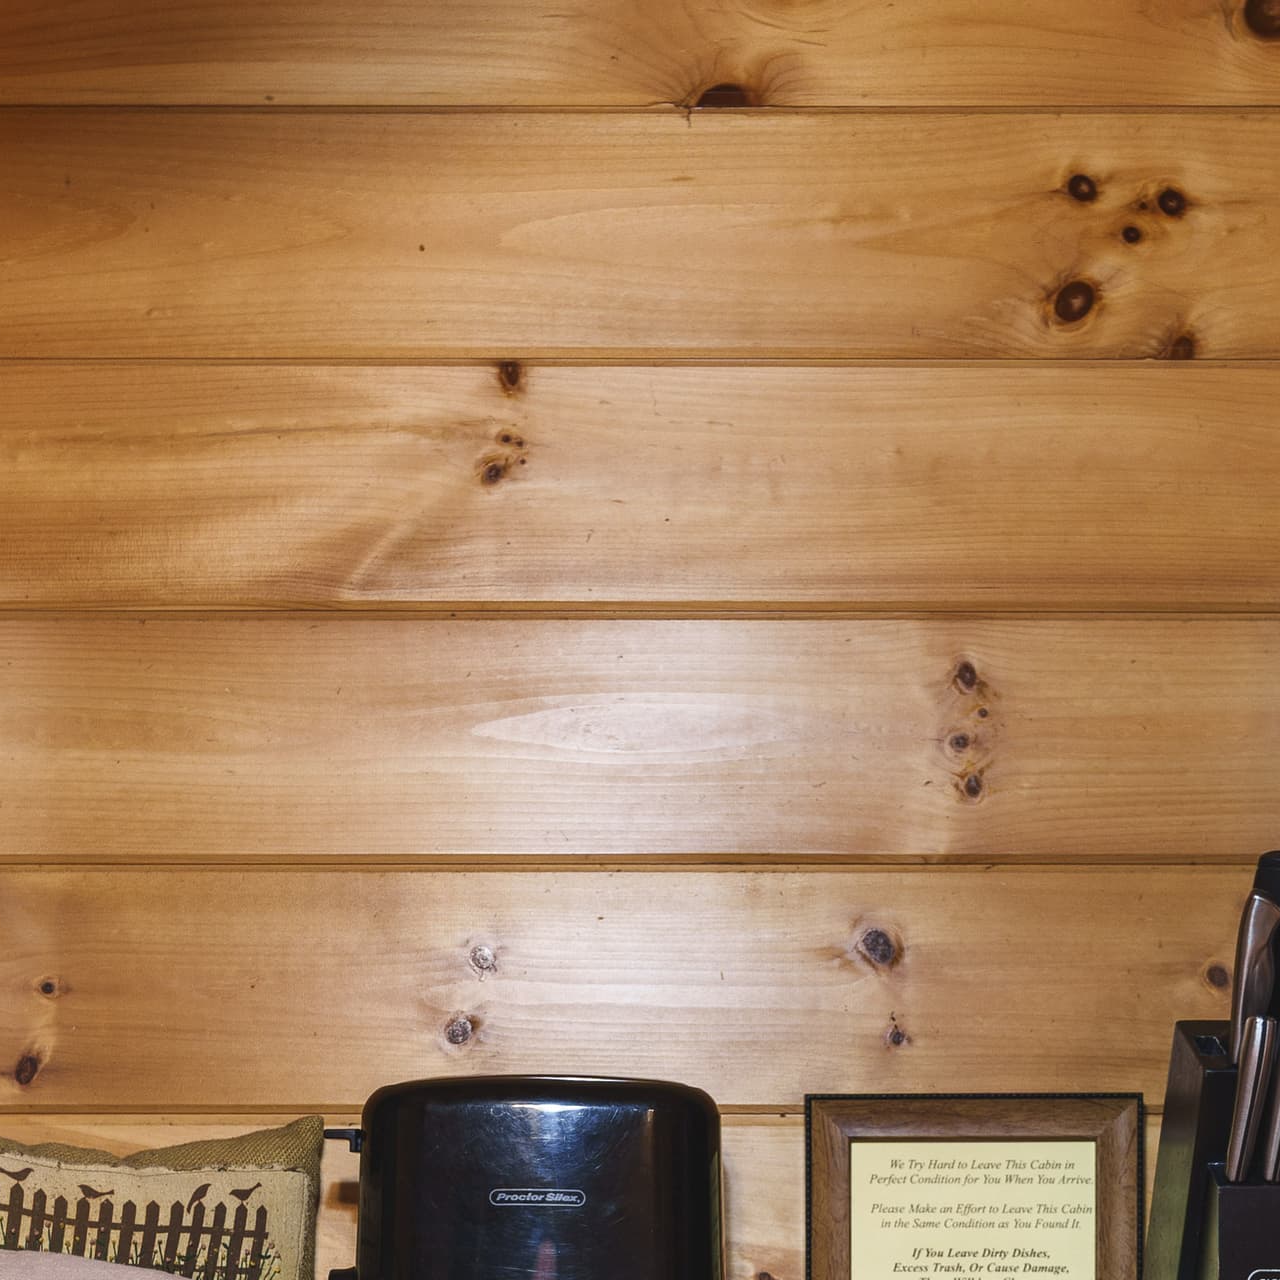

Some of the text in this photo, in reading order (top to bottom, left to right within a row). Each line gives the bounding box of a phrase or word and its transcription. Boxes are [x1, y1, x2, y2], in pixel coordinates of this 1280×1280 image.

[890, 1160, 1075, 1172] We Try Hard to Leave This Cabin in
[870, 1174, 1094, 1187] Perfect Condition for You When You Arrive.
[496, 1192, 544, 1201] Proctor
[870, 1203, 1093, 1216] Please Make an Effort to Leave This Cabin
[880, 1219, 891, 1229] in
[894, 1219, 910, 1229] the
[912, 1219, 941, 1229] Same
[944, 1219, 996, 1229] Condition
[998, 1221, 1009, 1229] as
[1014, 1219, 1032, 1229] You
[1034, 1219, 1070, 1229] Found
[912, 1248, 1051, 1260] If You Leave Dirty Dishes,
[893, 1263, 929, 1273] Excess
[933, 1263, 966, 1273] Trash,
[969, 1263, 984, 1273] Or
[987, 1263, 1020, 1273] Cause
